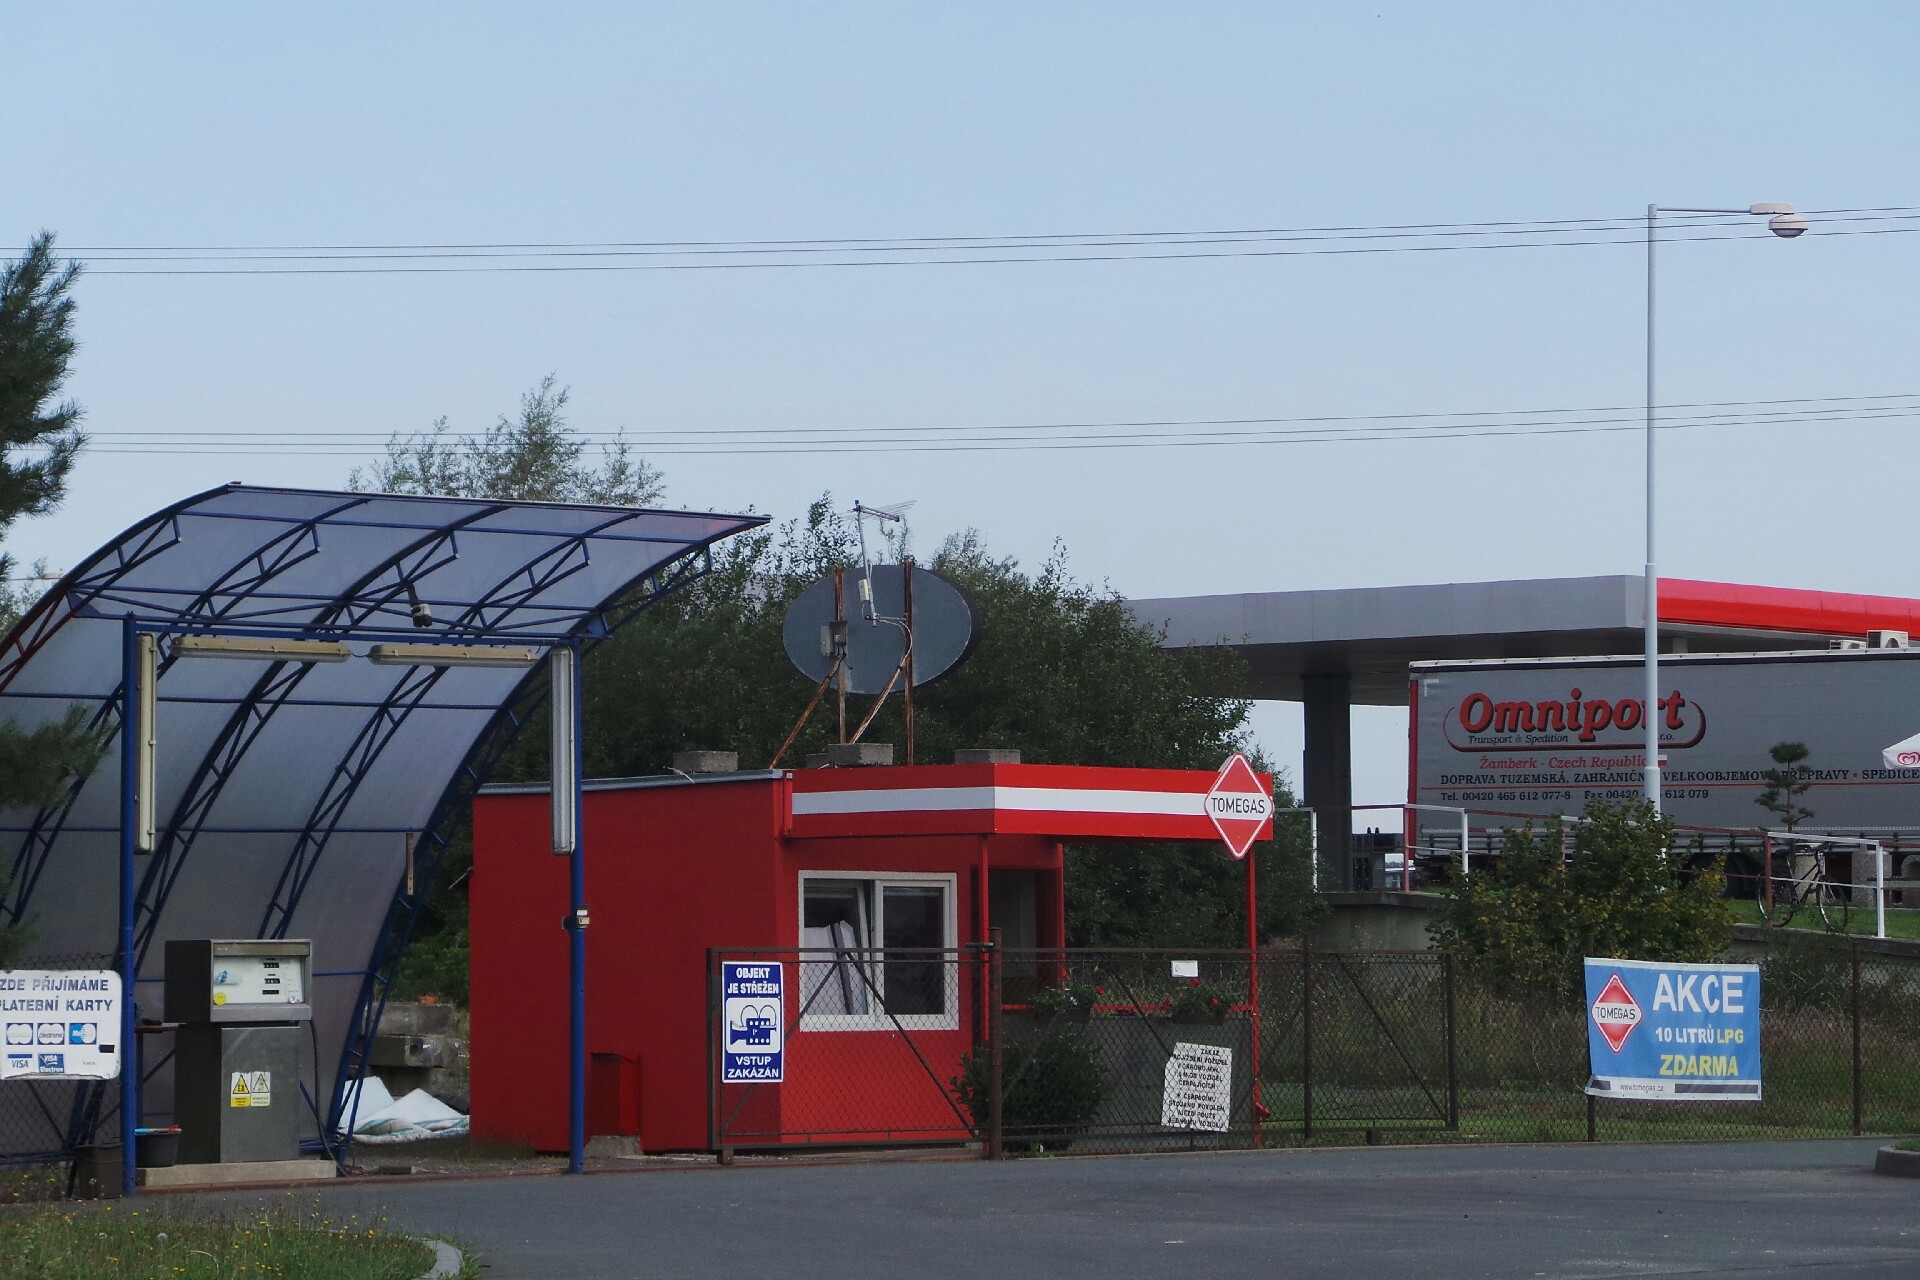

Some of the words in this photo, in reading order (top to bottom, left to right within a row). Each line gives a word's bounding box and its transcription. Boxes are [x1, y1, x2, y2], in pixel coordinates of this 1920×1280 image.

[1459, 687, 1685, 742] Omniport
[1468, 735, 1512, 745] Transport
[1525, 734, 1568, 745] Spedition
[1480, 755, 1537, 769] Žamberk
[1549, 757, 1587, 769] Czech
[1440, 775, 1496, 785] DOPRAVA
[1862, 769, 1920, 780] SPEDICE
[1441, 792, 1459, 801] Tel.
[1462, 792, 1494, 801] 00420
[1497, 791, 1516, 800] 465
[1519, 791, 1539, 800] 612
[1541, 791, 1571, 800] 077-8
[1584, 790, 1603, 800] Fax
[1606, 790, 1639, 799] 00420
[1665, 789, 1685, 799] 612
[1688, 789, 1709, 799] 079
[1211, 797, 1265, 814] TOMEGAS
[736, 967, 770, 979] OBJEKT
[0, 979, 26, 991] ZDE
[33, 975, 109, 991] PŘIJÍMÁME
[727, 983, 739, 994] JE
[740, 981, 779, 994] STŘEŽEN
[1652, 973, 1744, 1014] AKCE
[0, 995, 59, 1011] LATEBNÍ
[66, 999, 113, 1011] KARTY
[1595, 1006, 1636, 1020] TOMEGAS
[1655, 1027, 1672, 1042] 10
[1675, 1024, 1713, 1044] LITRŮ
[1716, 1029, 1744, 1044] LPG
[12, 1060, 29, 1069] VISA
[44, 1054, 58, 1062] VISA
[736, 1056, 772, 1066] VSTUP
[40, 1066, 64, 1074] Electron
[1659, 1054, 1739, 1077] ZDARMA
[727, 1067, 779, 1078] ZAKÁZÁN
